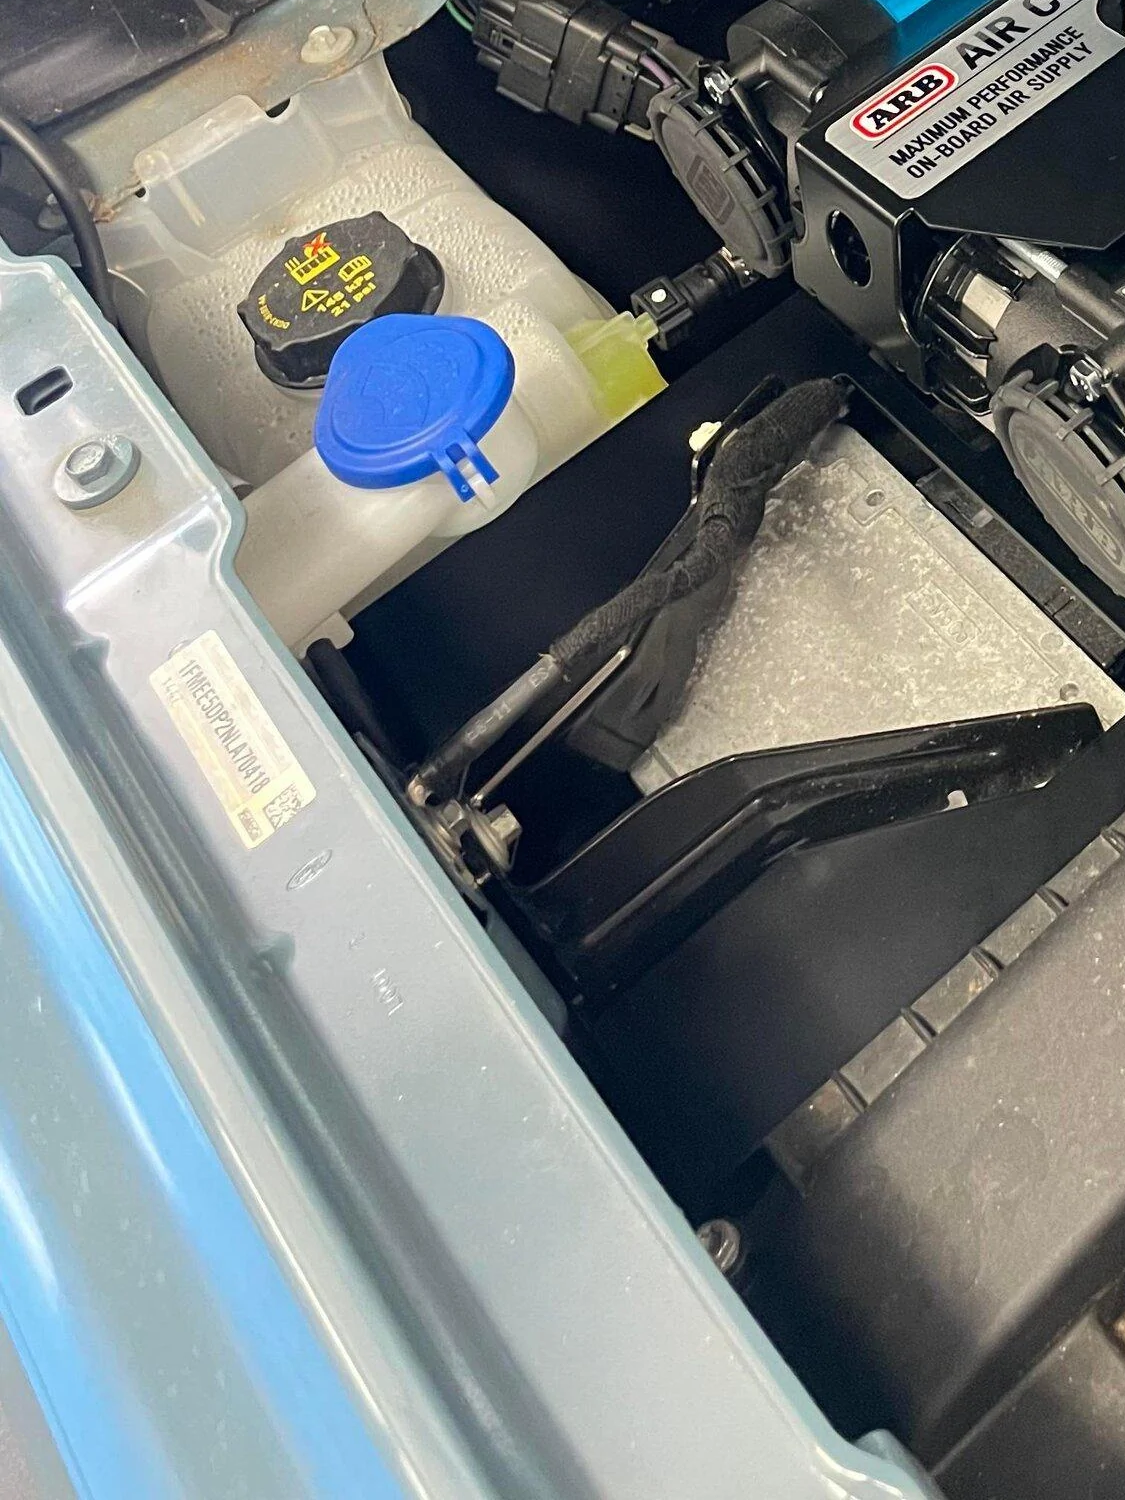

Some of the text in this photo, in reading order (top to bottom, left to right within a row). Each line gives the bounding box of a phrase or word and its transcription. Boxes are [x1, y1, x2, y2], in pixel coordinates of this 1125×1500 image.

[956, 14, 1030, 71] AIR
[866, 70, 946, 132] ARB
[889, 25, 1084, 167] MAXIMUM PERFORMANCE
[906, 41, 1092, 180] ON-BOARD AIR SUPPLY
[332, 282, 377, 317] 21 psi
[177, 658, 271, 795] 1FMEE5DP2NLA70418
